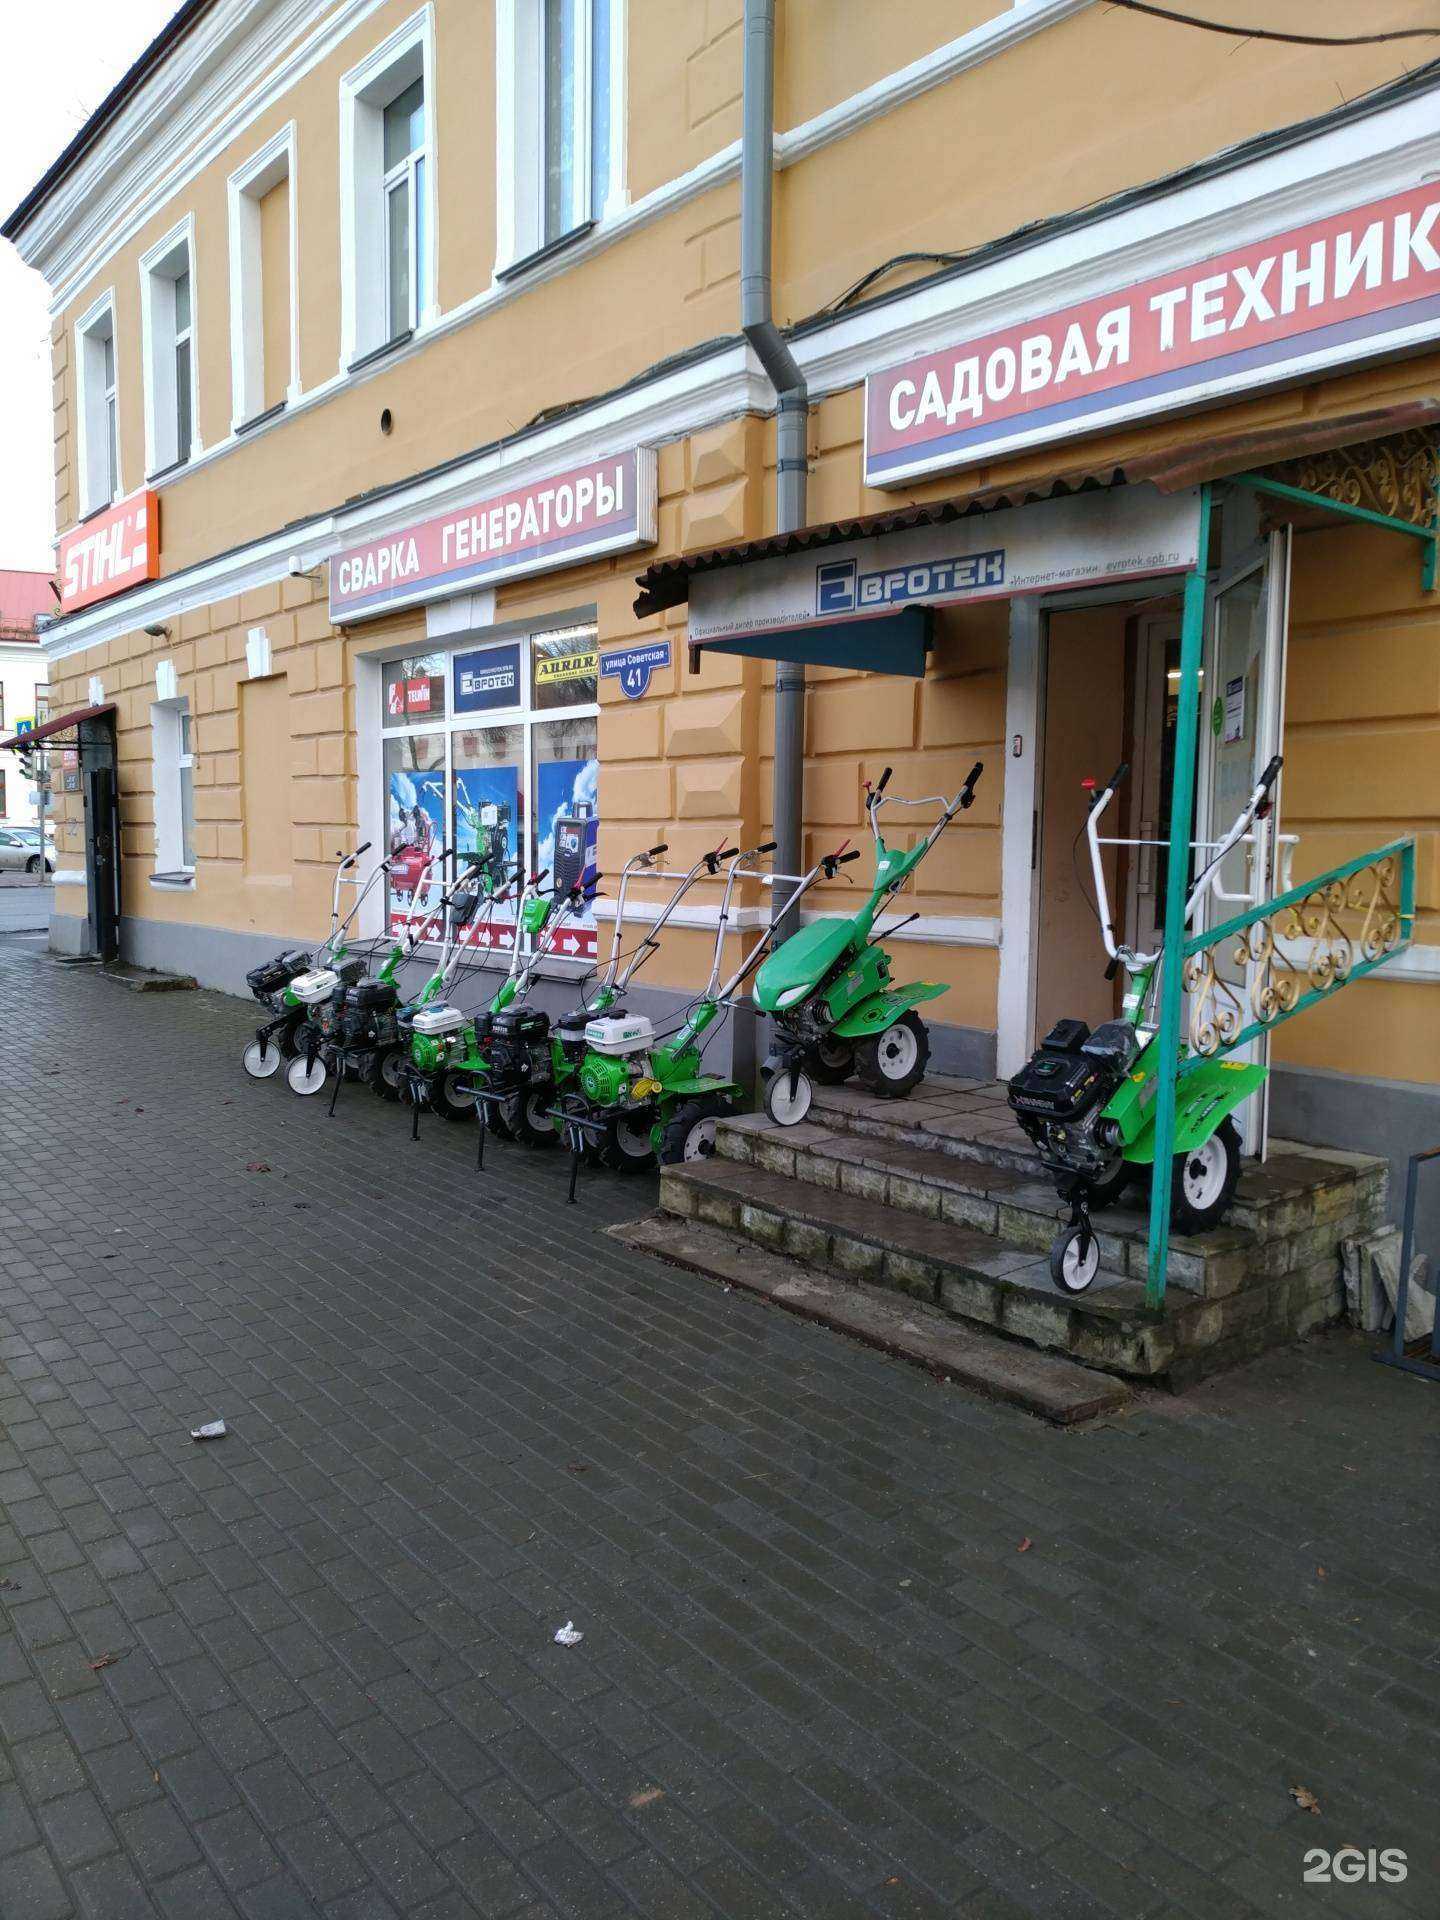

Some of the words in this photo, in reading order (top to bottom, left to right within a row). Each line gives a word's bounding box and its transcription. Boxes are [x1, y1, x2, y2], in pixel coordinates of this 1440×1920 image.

[889, 305, 1131, 430] САДОВАЯ
[1150, 201, 1440, 352] ТЕХНИК
[63, 519, 132, 599] STIHL
[338, 537, 420, 595] СВАРКА
[441, 464, 624, 565] ГЕНЕРАТОРЫ
[605, 657, 627, 671] улица
[627, 650, 665, 665] Советская
[627, 667, 642, 688] 41
